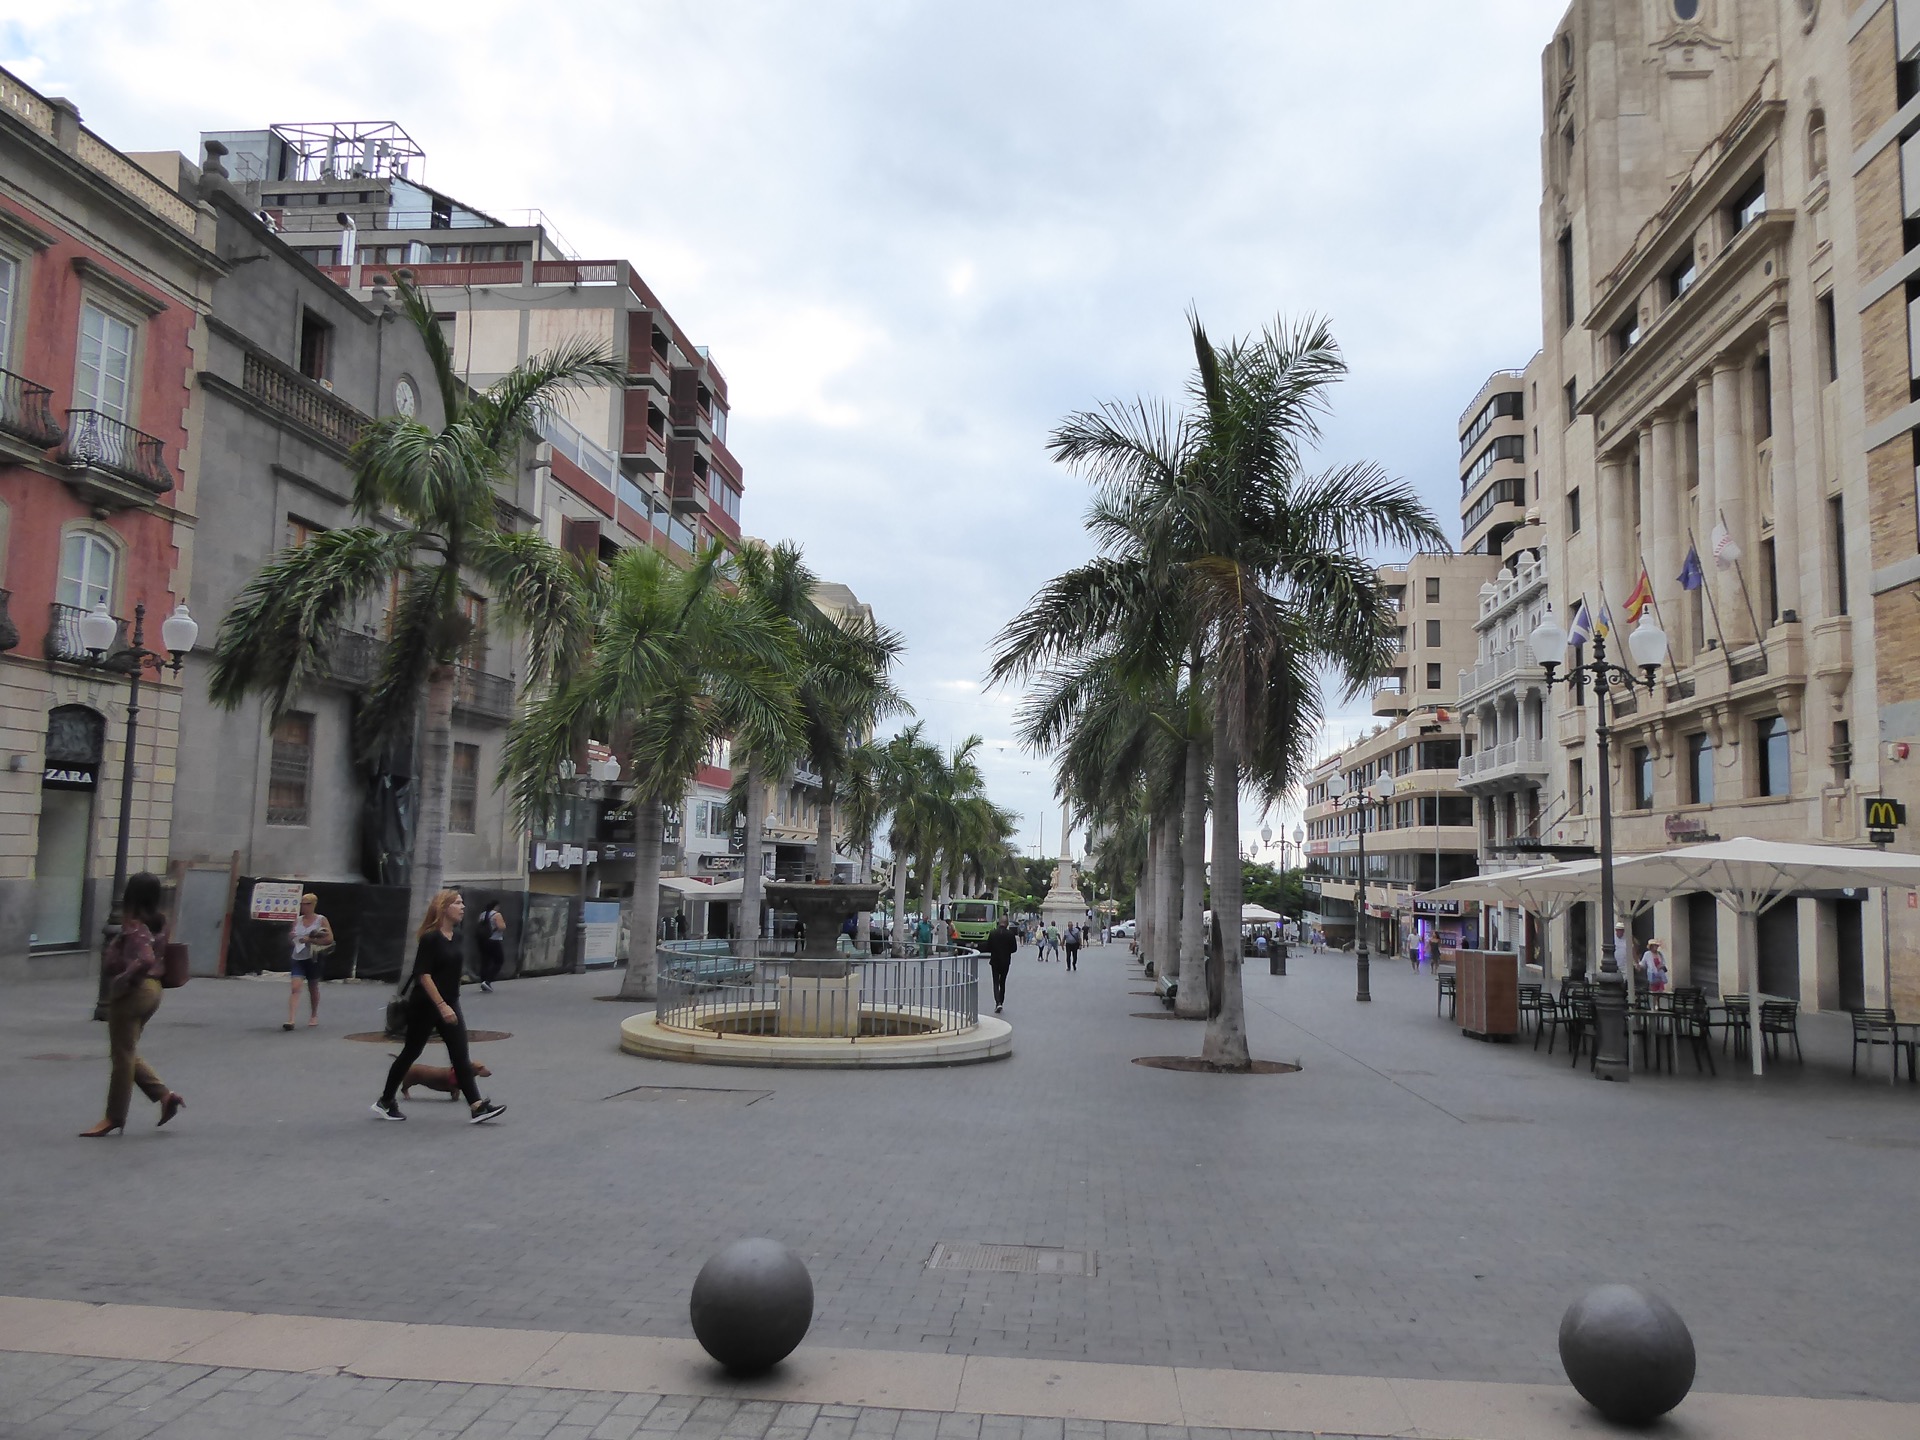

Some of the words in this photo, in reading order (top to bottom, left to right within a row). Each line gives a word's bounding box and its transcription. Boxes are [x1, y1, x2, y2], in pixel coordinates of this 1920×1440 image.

[45, 768, 92, 783] ZARA
[706, 857, 742, 869] LIBERTY
[1417, 902, 1455, 911] FLIPPER
